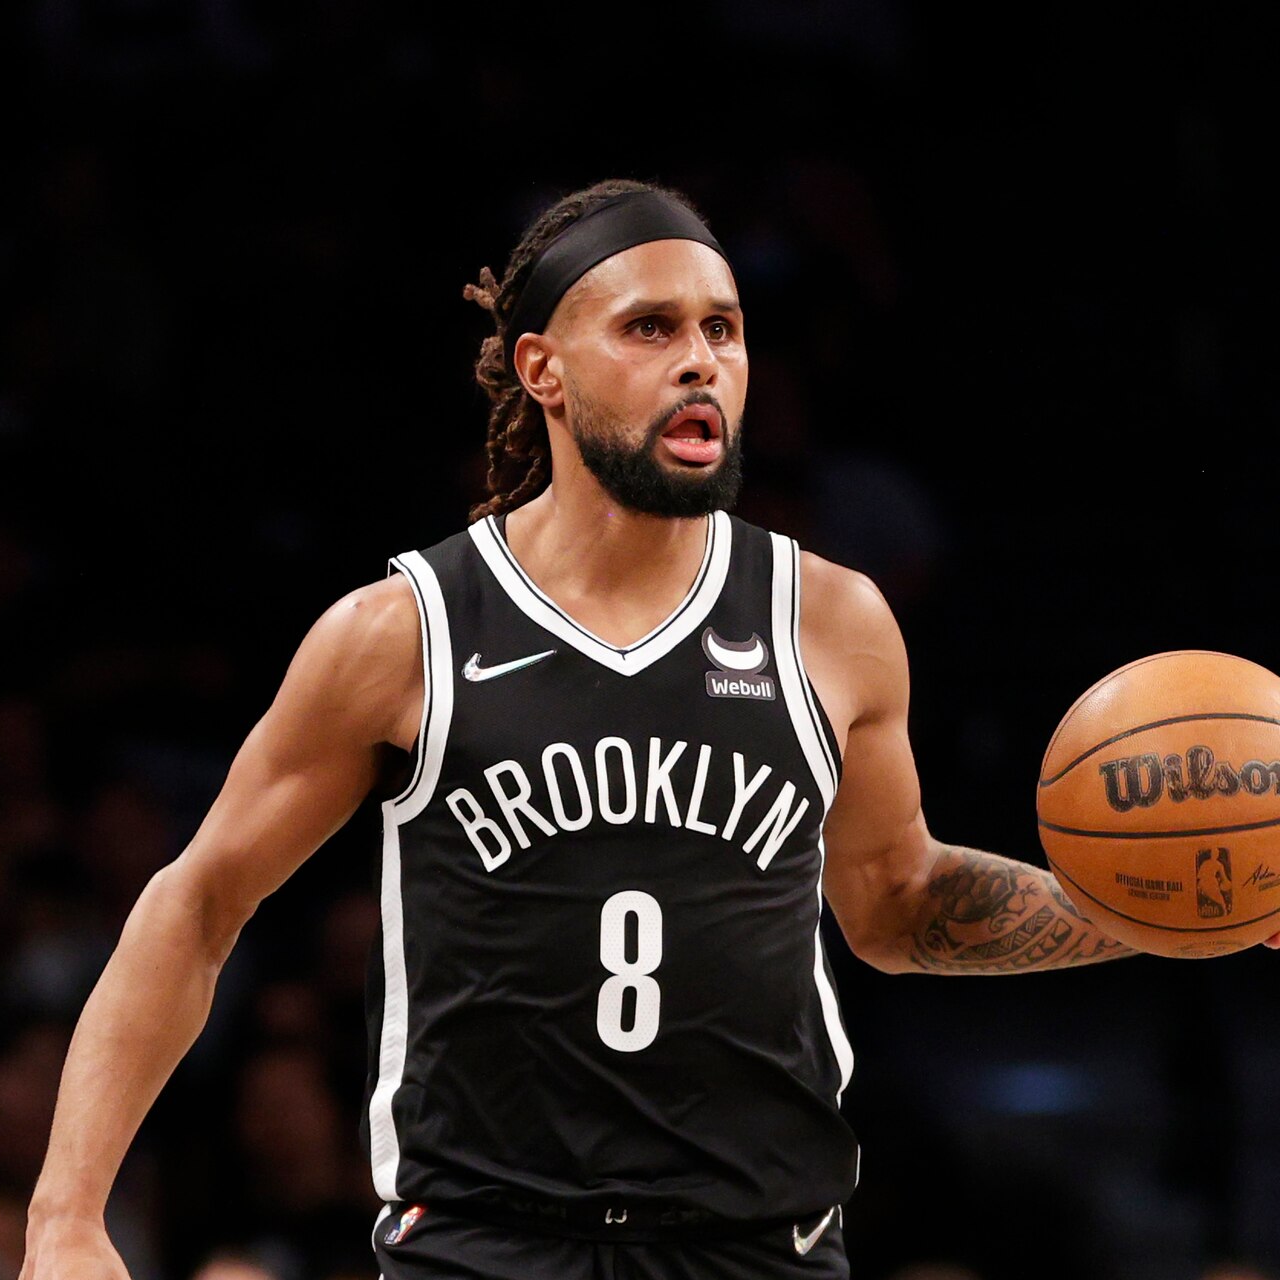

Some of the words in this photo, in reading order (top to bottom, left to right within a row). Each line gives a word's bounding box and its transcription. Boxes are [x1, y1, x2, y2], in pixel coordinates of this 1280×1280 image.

[711, 678, 772, 698] Webull
[445, 736, 809, 873] BROOKLYN
[596, 890, 663, 1052] 8
